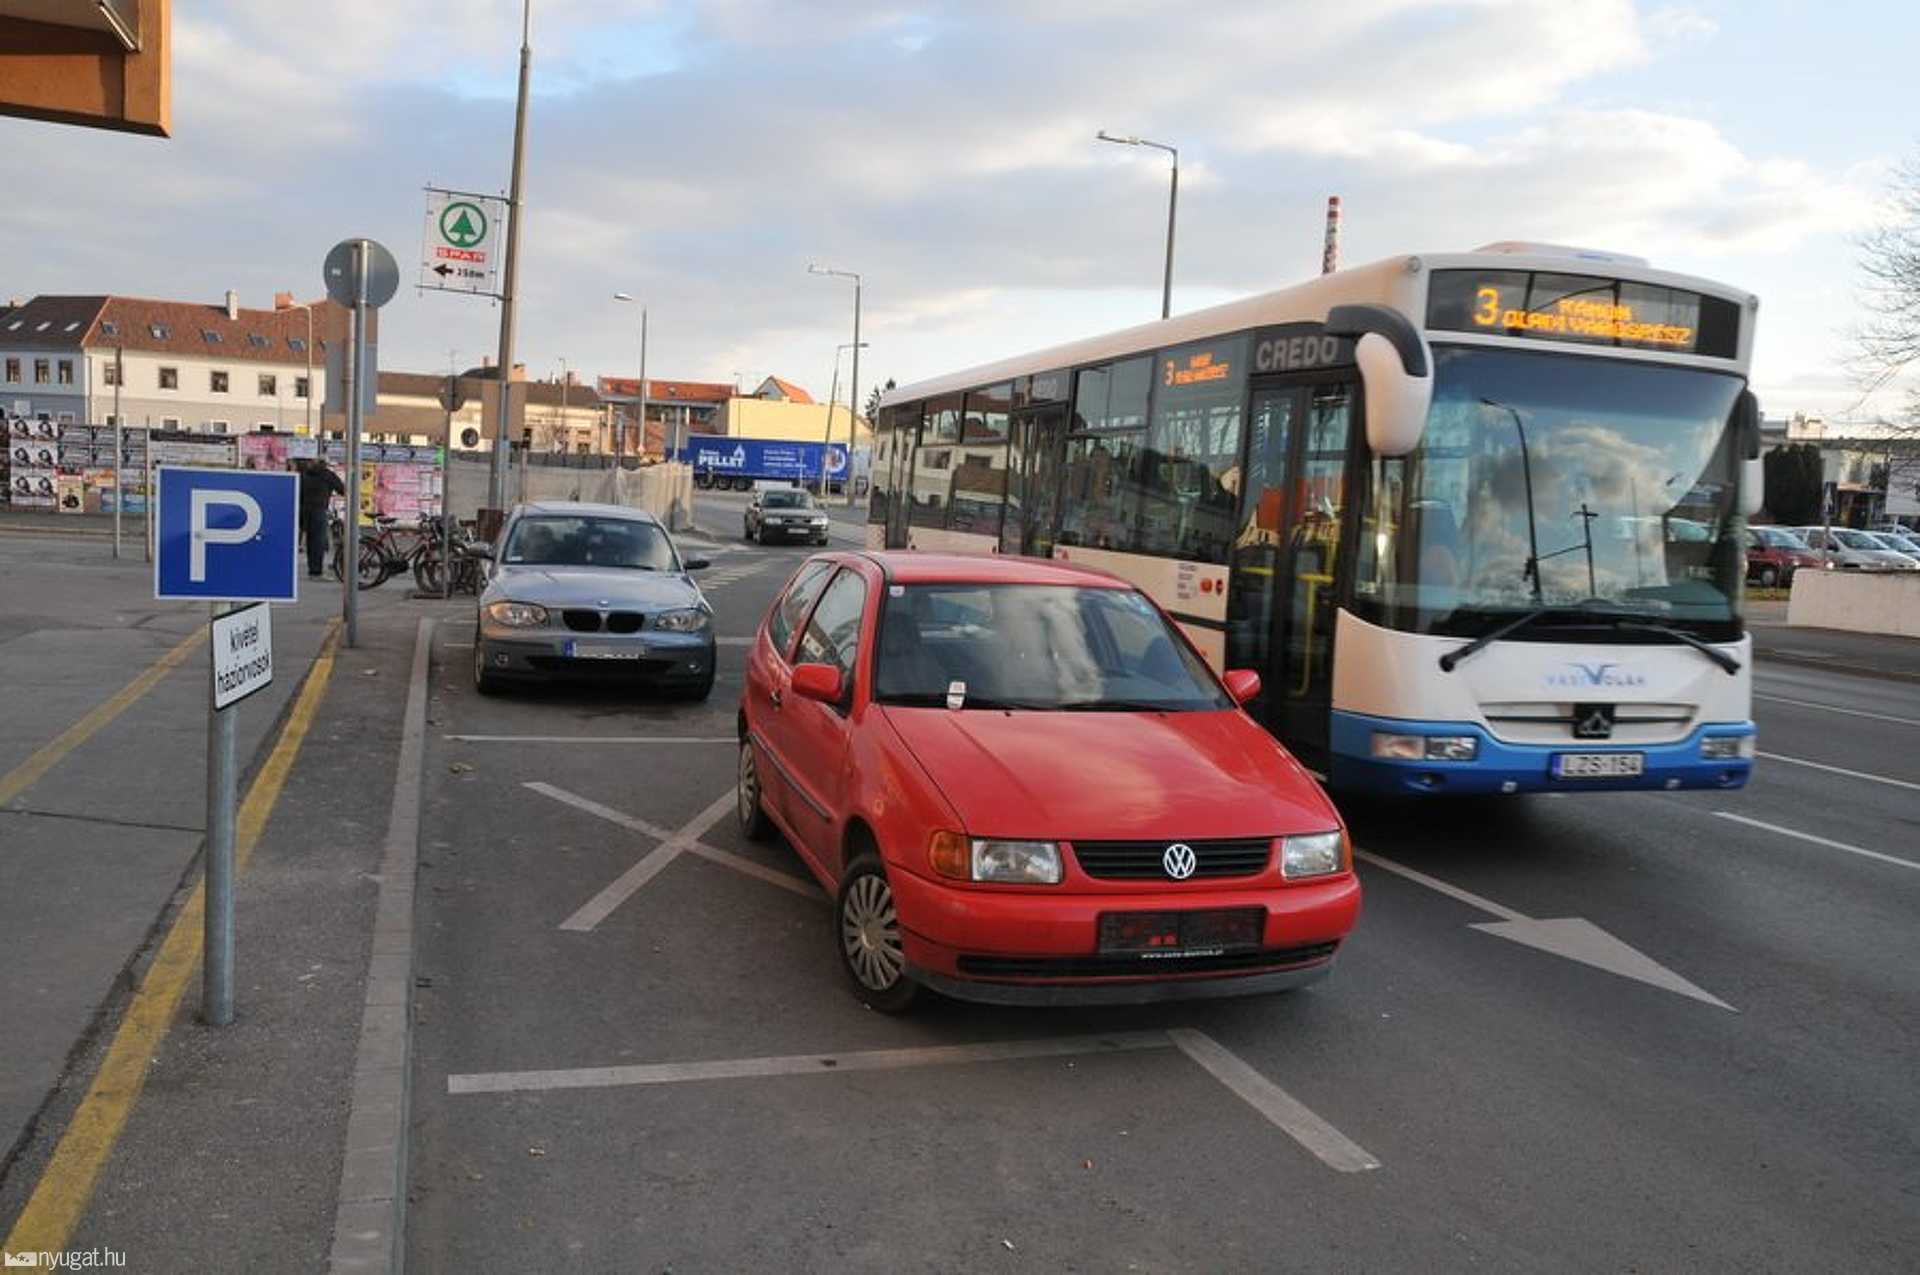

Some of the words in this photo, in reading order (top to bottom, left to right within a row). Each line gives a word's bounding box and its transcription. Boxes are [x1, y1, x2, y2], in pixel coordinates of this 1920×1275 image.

[436, 247, 486, 262] SPAR
[1474, 287, 1500, 325] 3
[1256, 335, 1340, 369] CREDO
[190, 489, 262, 582] P
